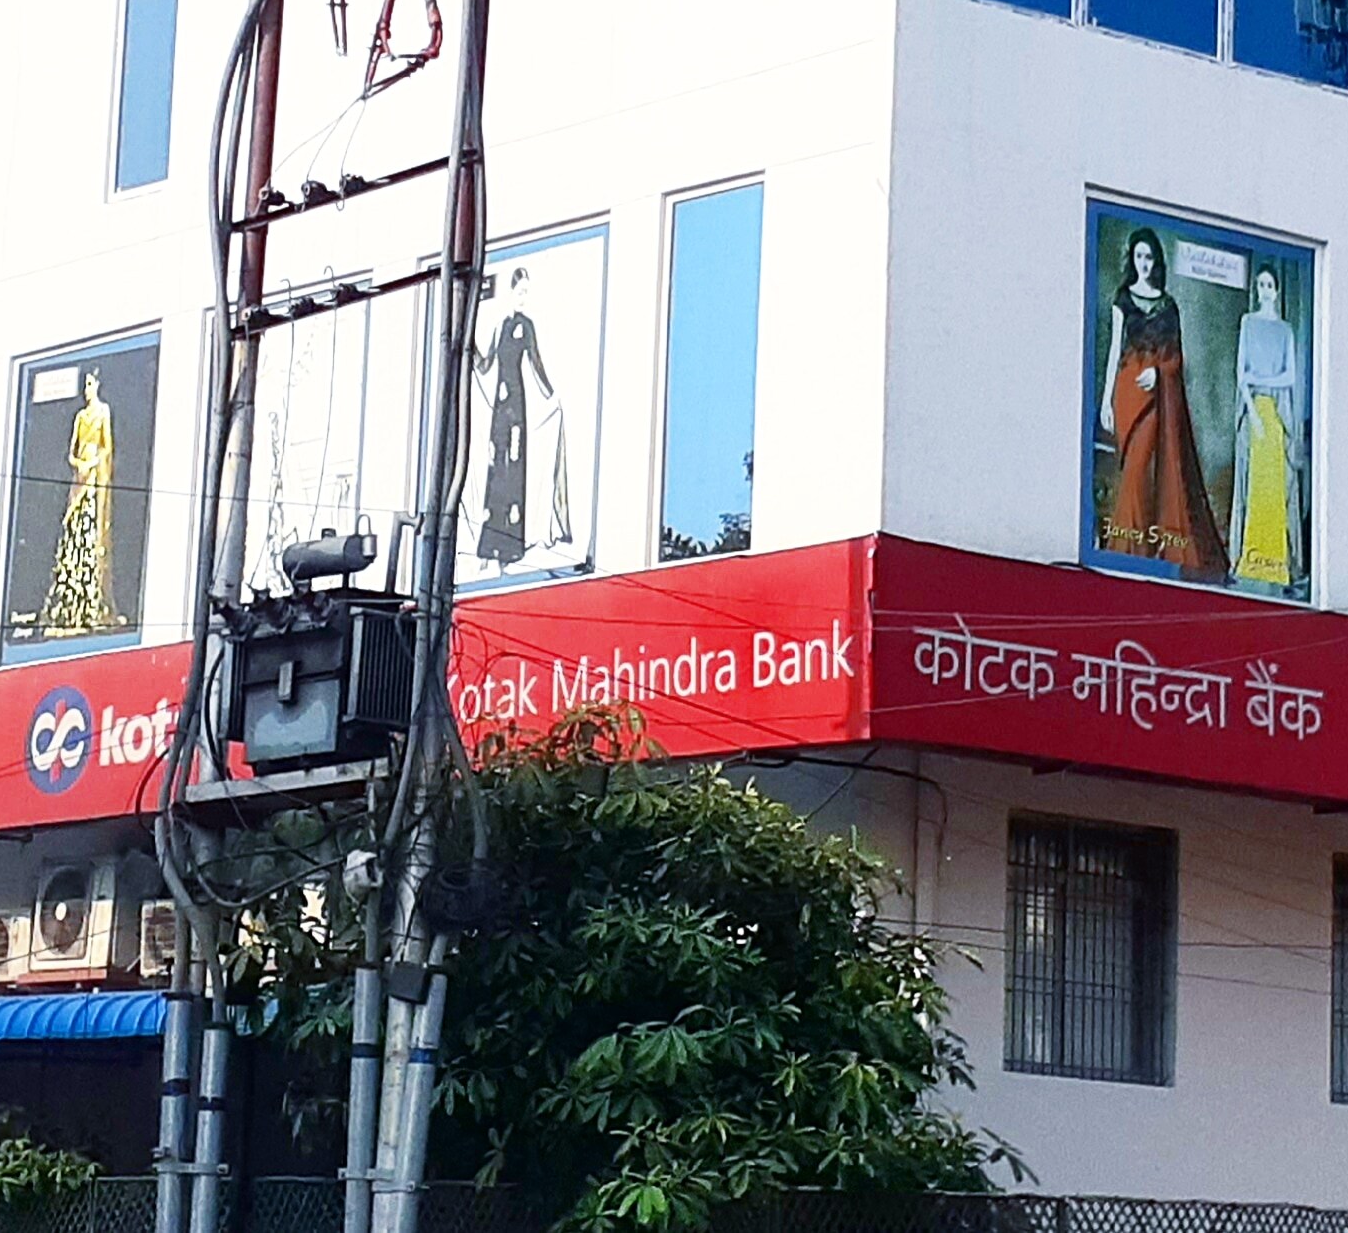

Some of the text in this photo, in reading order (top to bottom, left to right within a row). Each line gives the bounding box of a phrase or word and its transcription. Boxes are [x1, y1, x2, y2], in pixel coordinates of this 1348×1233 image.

[447, 619, 855, 725] otak Mahindra Bank
[912, 613, 1324, 741] कोटक महिन्द्रा बैंक
[99, 697, 182, 767] kot
